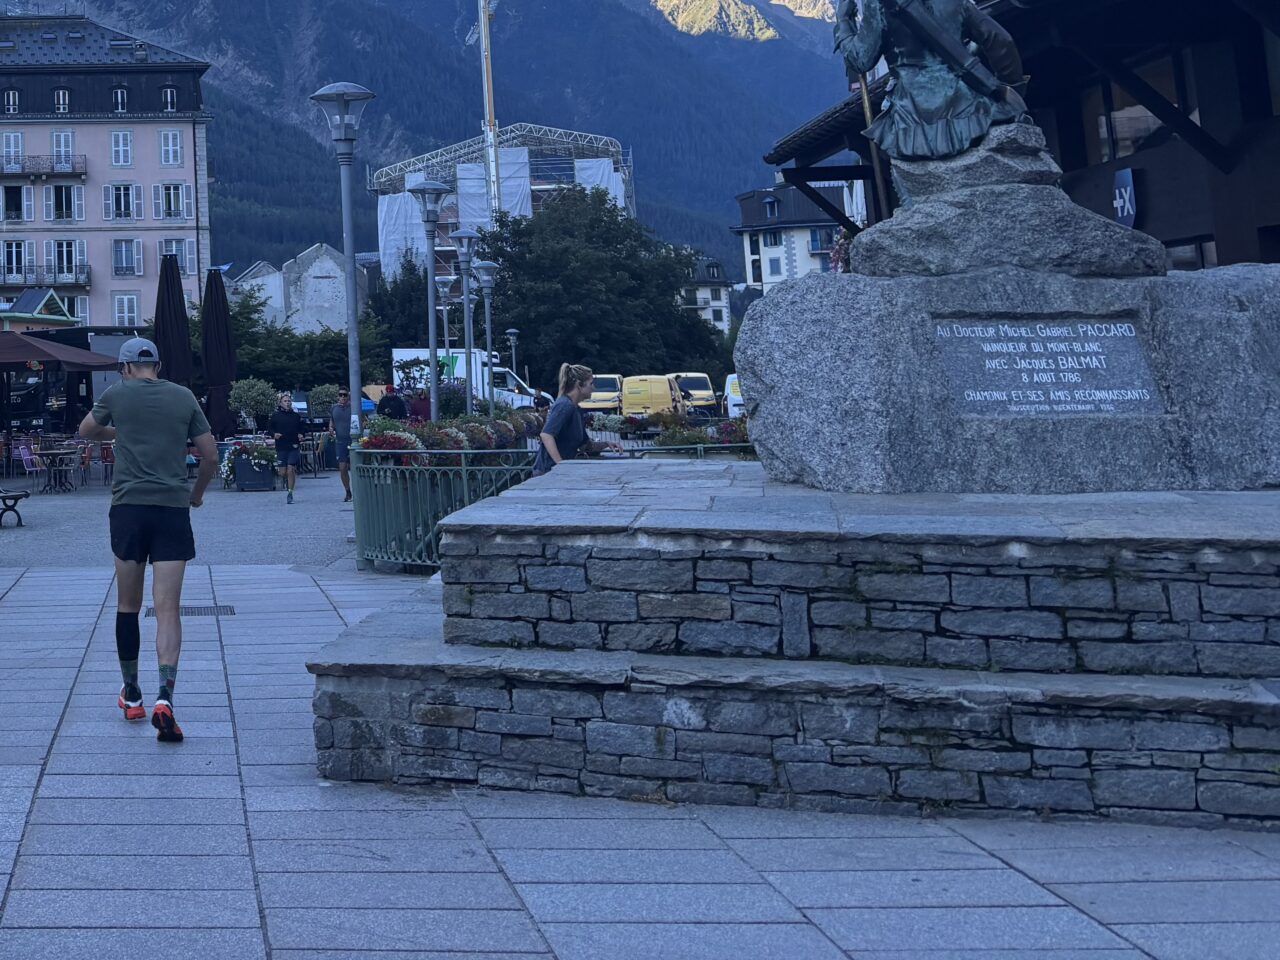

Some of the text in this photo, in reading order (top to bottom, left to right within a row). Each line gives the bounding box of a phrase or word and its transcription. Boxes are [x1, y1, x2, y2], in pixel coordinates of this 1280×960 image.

[1077, 323, 1136, 337] PACCARD
[981, 342, 1102, 353] VAINQUEUR DU MONT-BLANC
[985, 359, 1008, 369] AVEC
[1057, 355, 1107, 369] BALMAT
[1021, 372, 1082, 383] 8 AOUT 1786
[964, 389, 1150, 401] CHAMONIX ET SES AMIS RECONNAISSANTS
